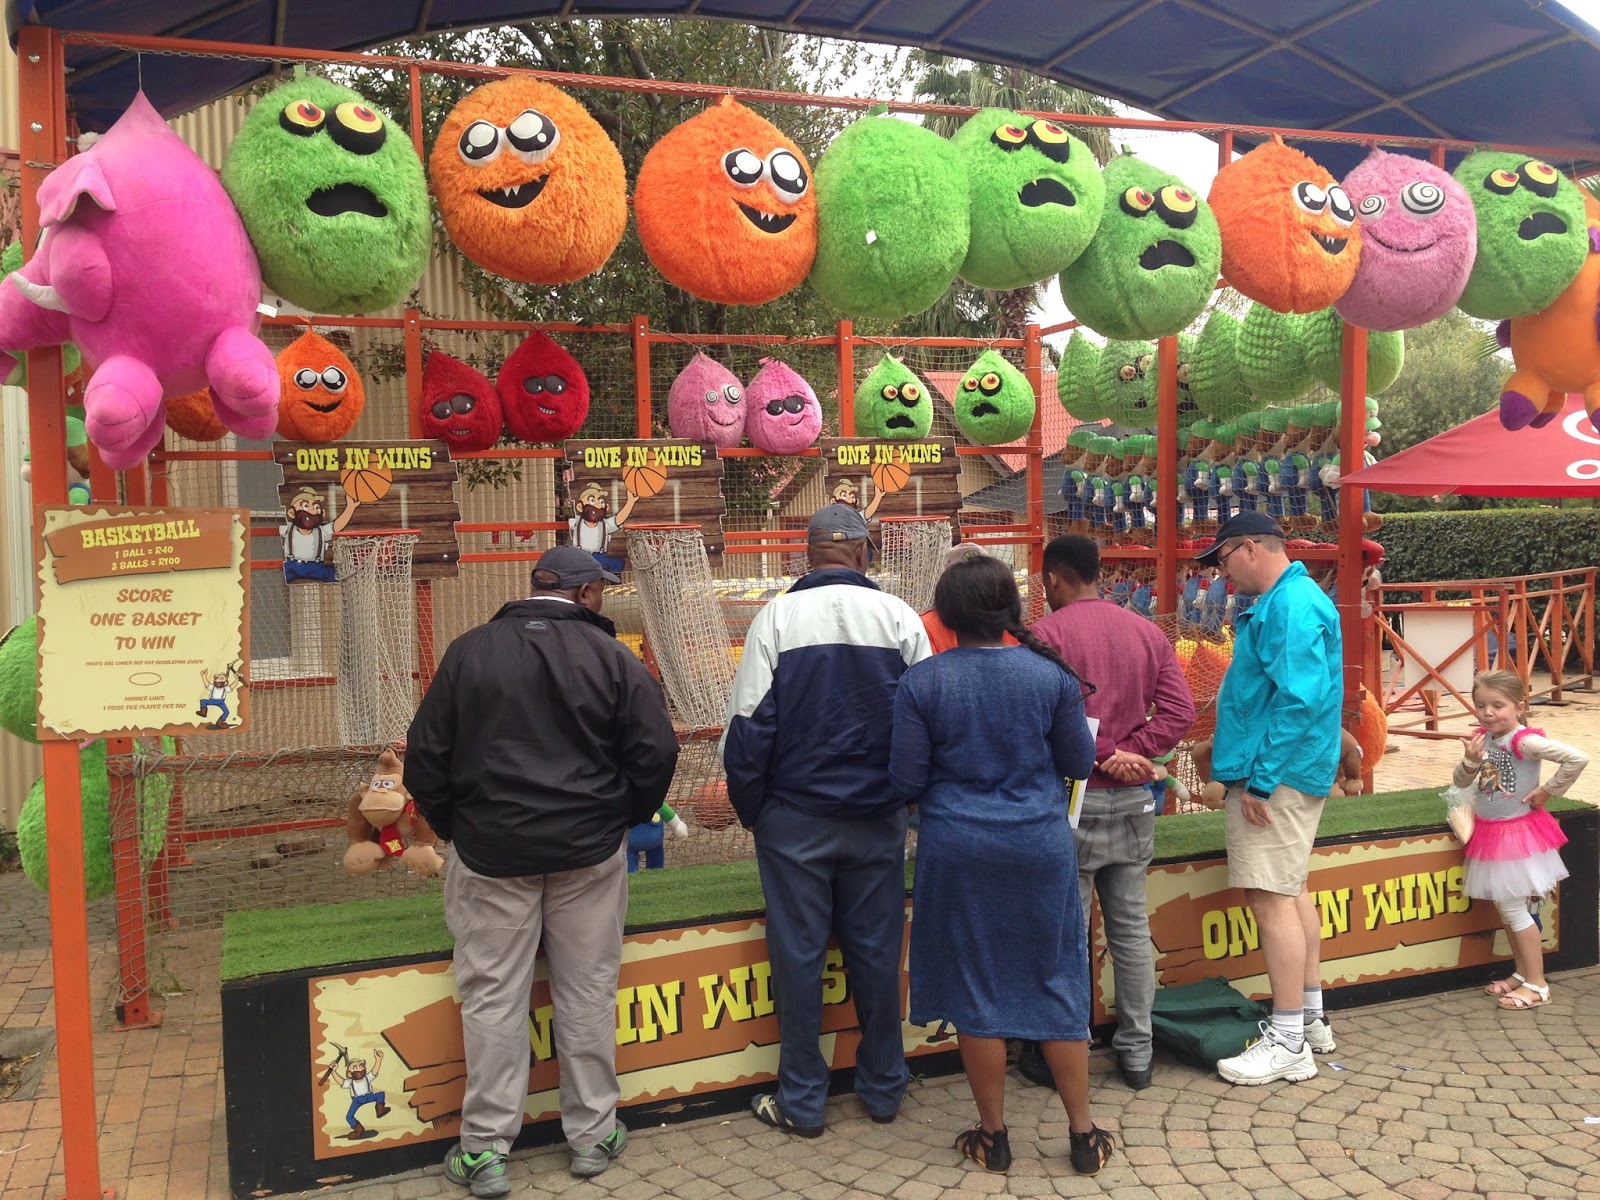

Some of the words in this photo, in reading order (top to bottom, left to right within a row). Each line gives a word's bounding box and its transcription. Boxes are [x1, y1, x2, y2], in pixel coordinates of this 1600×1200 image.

[296, 448, 339, 471] ONE
[345, 447, 370, 470] IN
[375, 446, 432, 470] WINS
[584, 446, 621, 468] ONE
[626, 446, 649, 468] IN
[653, 445, 702, 467] WINS
[837, 444, 870, 465] ONE
[874, 444, 894, 465] IN
[898, 443, 942, 464] WINS
[80, 519, 200, 549] BASKETBALL
[115, 550, 120, 558] 1
[122, 548, 146, 558] BALL
[155, 546, 174, 555] R40
[111, 562, 118, 571] 3
[120, 559, 148, 570] BALLS
[158, 557, 180, 566] R100
[116, 588, 174, 603] SCORE
[90, 612, 126, 627] ONE
[131, 611, 203, 626] BASKET
[114, 635, 137, 650] TO
[141, 635, 176, 650] WIN
[1202, 906, 1259, 960] ON
[1309, 887, 1350, 940] N
[1362, 866, 1470, 931] WINS
[698, 948, 848, 1030] WIS
